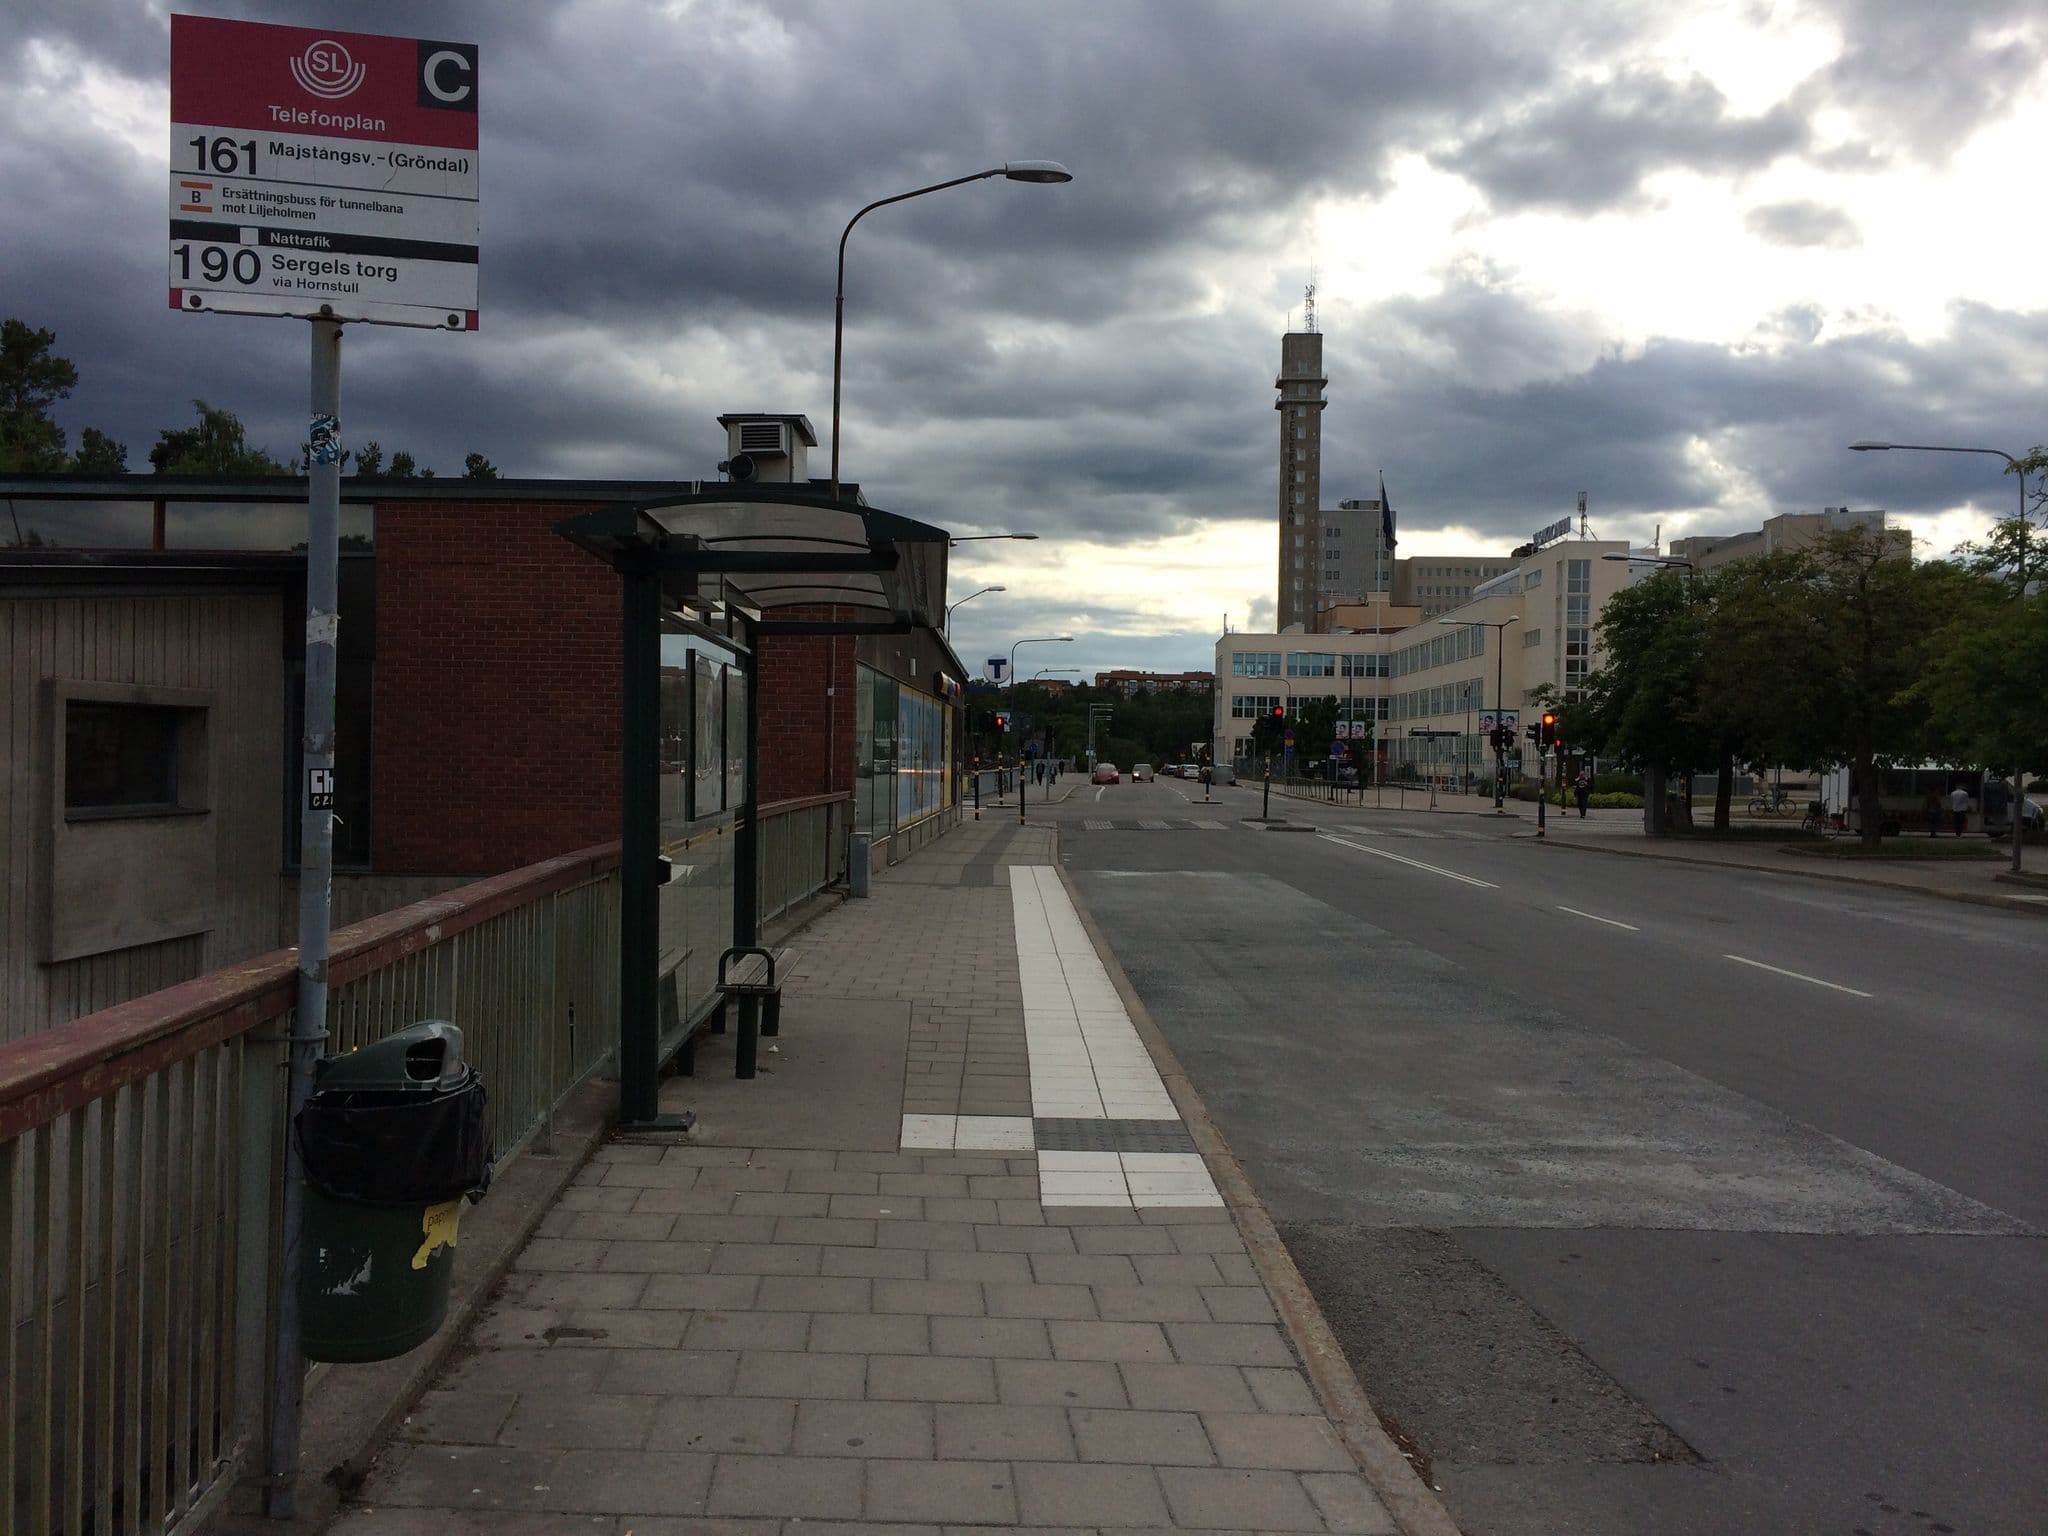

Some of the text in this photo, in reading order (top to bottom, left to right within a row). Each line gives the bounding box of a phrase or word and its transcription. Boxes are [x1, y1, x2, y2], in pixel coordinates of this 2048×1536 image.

[311, 51, 345, 75] SL
[423, 50, 471, 103] C
[268, 105, 386, 132] Telefonplan
[189, 134, 257, 176] 161
[191, 190, 202, 204] B
[222, 187, 404, 215] Ersättningsbuss för tunnelbana
[222, 203, 316, 220] mot Liljeholmen
[270, 231, 331, 248] Nattrafik
[173, 243, 262, 285] 190
[271, 253, 398, 282] Sergels torg
[272, 276, 359, 294] via Hornstull
[988, 658, 1007, 679] T
